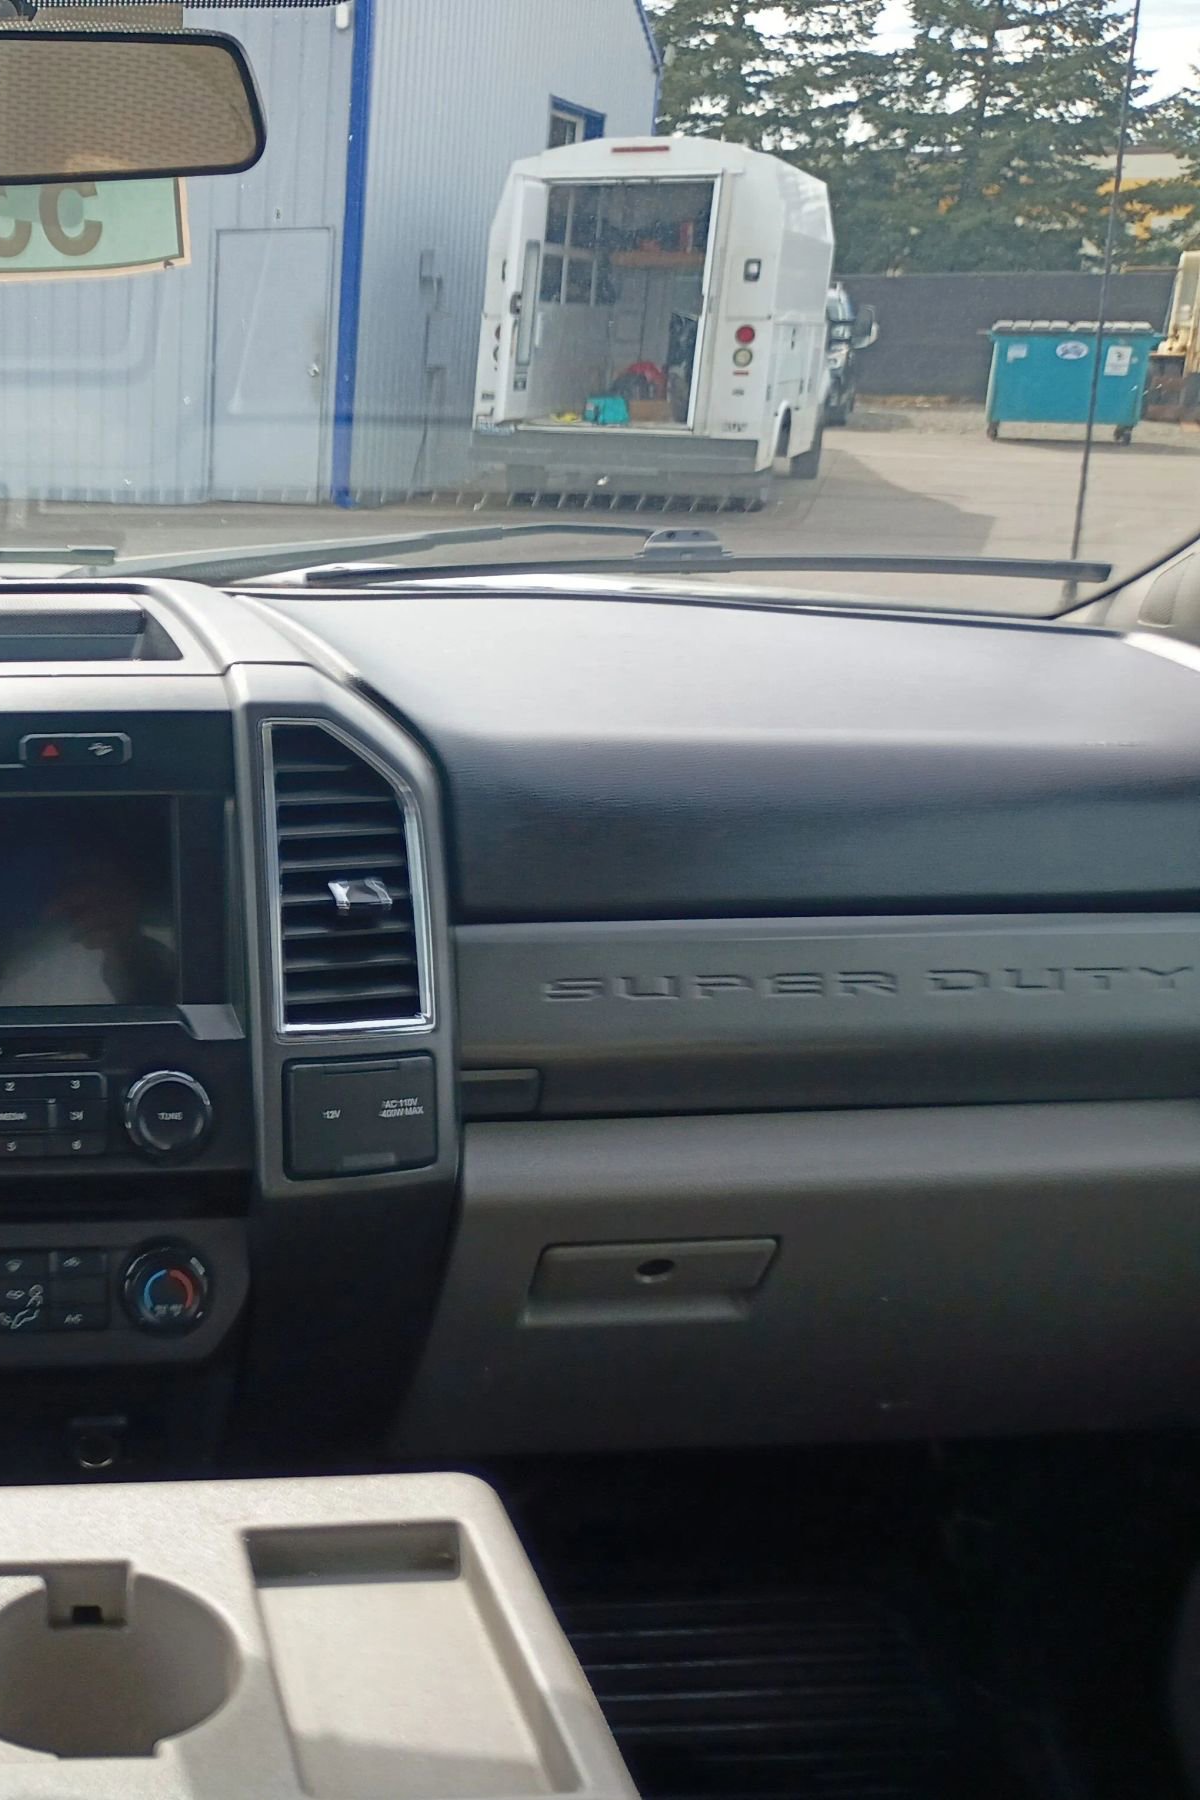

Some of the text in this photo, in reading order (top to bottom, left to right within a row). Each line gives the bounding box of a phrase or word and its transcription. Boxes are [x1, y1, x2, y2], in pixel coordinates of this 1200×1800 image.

[544, 966, 1194, 1000] SUPER DUTY
[6, 1081, 15, 1091] 2
[70, 1079, 81, 1089] 3
[383, 1100, 398, 1109] AC
[405, 1106, 424, 1116] MAX
